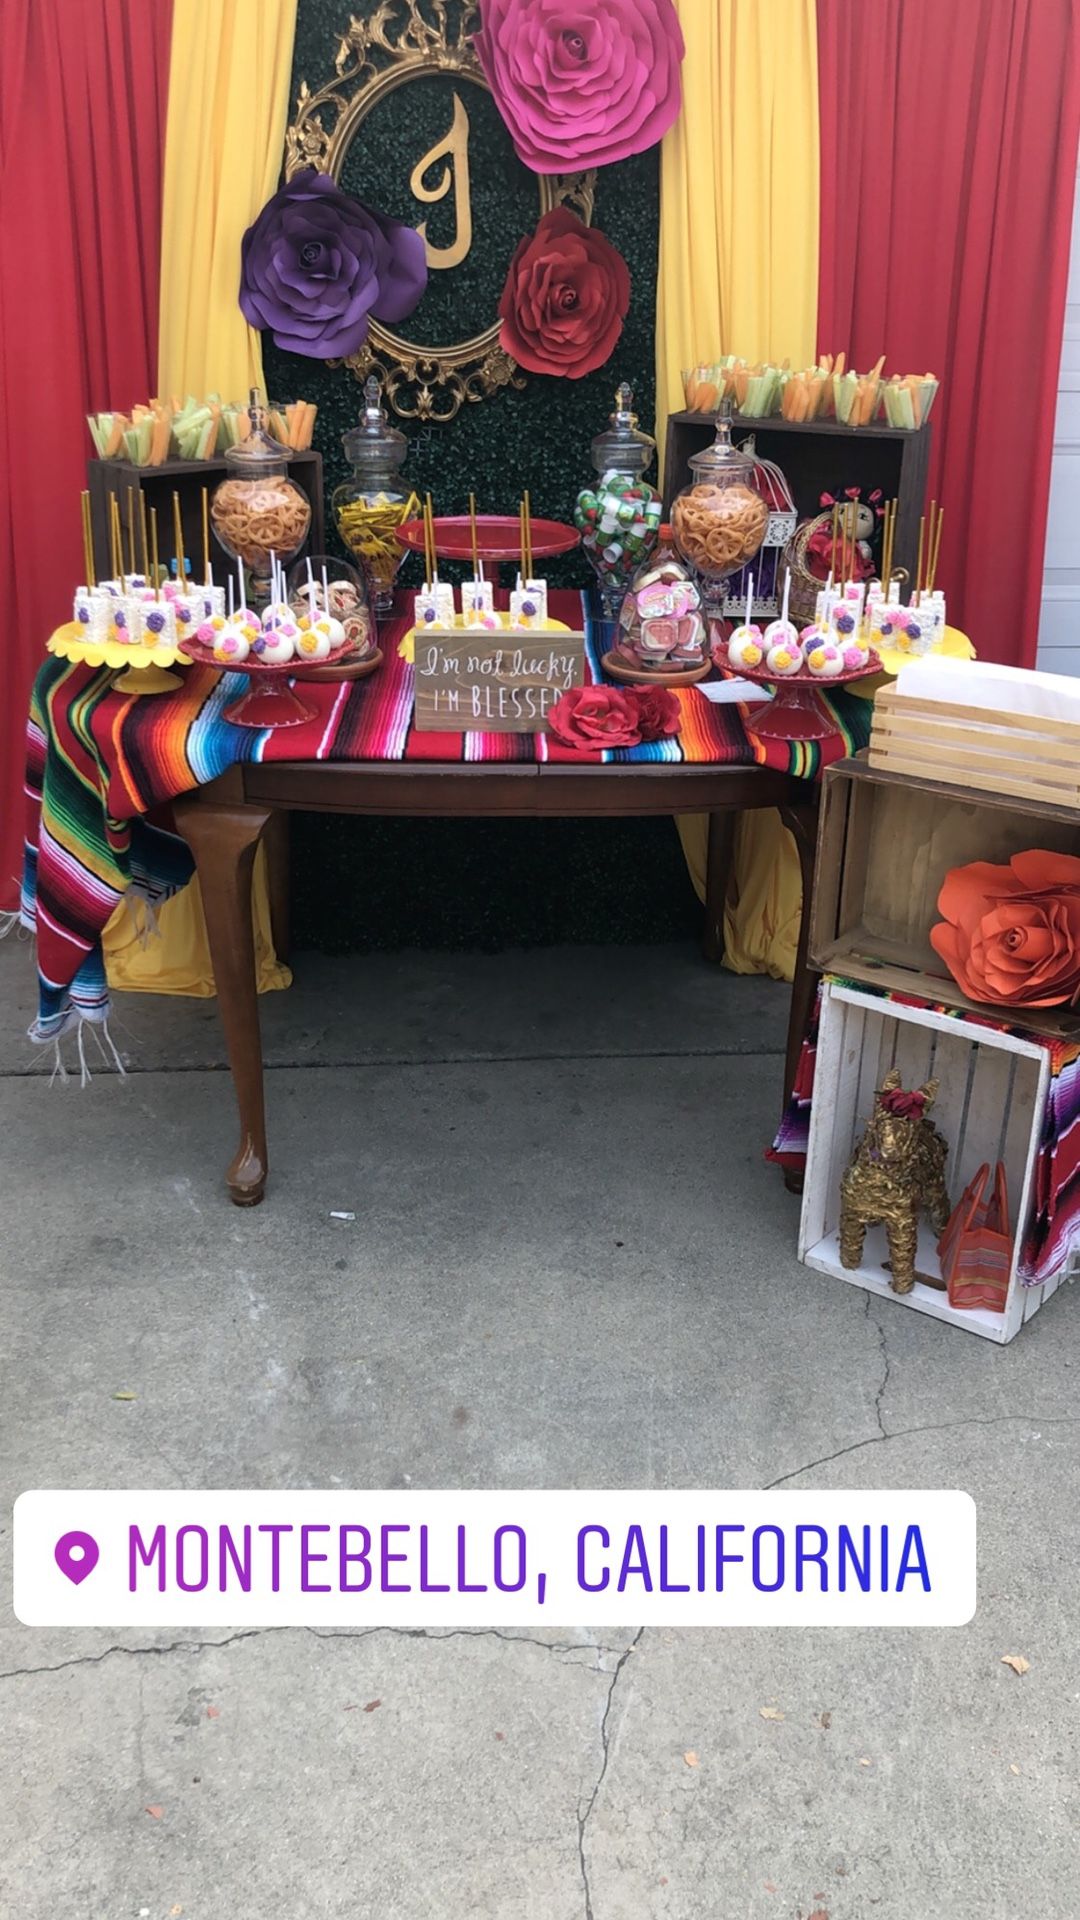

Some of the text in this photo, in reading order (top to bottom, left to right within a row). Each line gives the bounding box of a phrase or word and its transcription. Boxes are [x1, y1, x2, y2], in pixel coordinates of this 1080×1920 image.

[420, 647, 577, 690] I'm not lucky.
[434, 689, 459, 712] I'M
